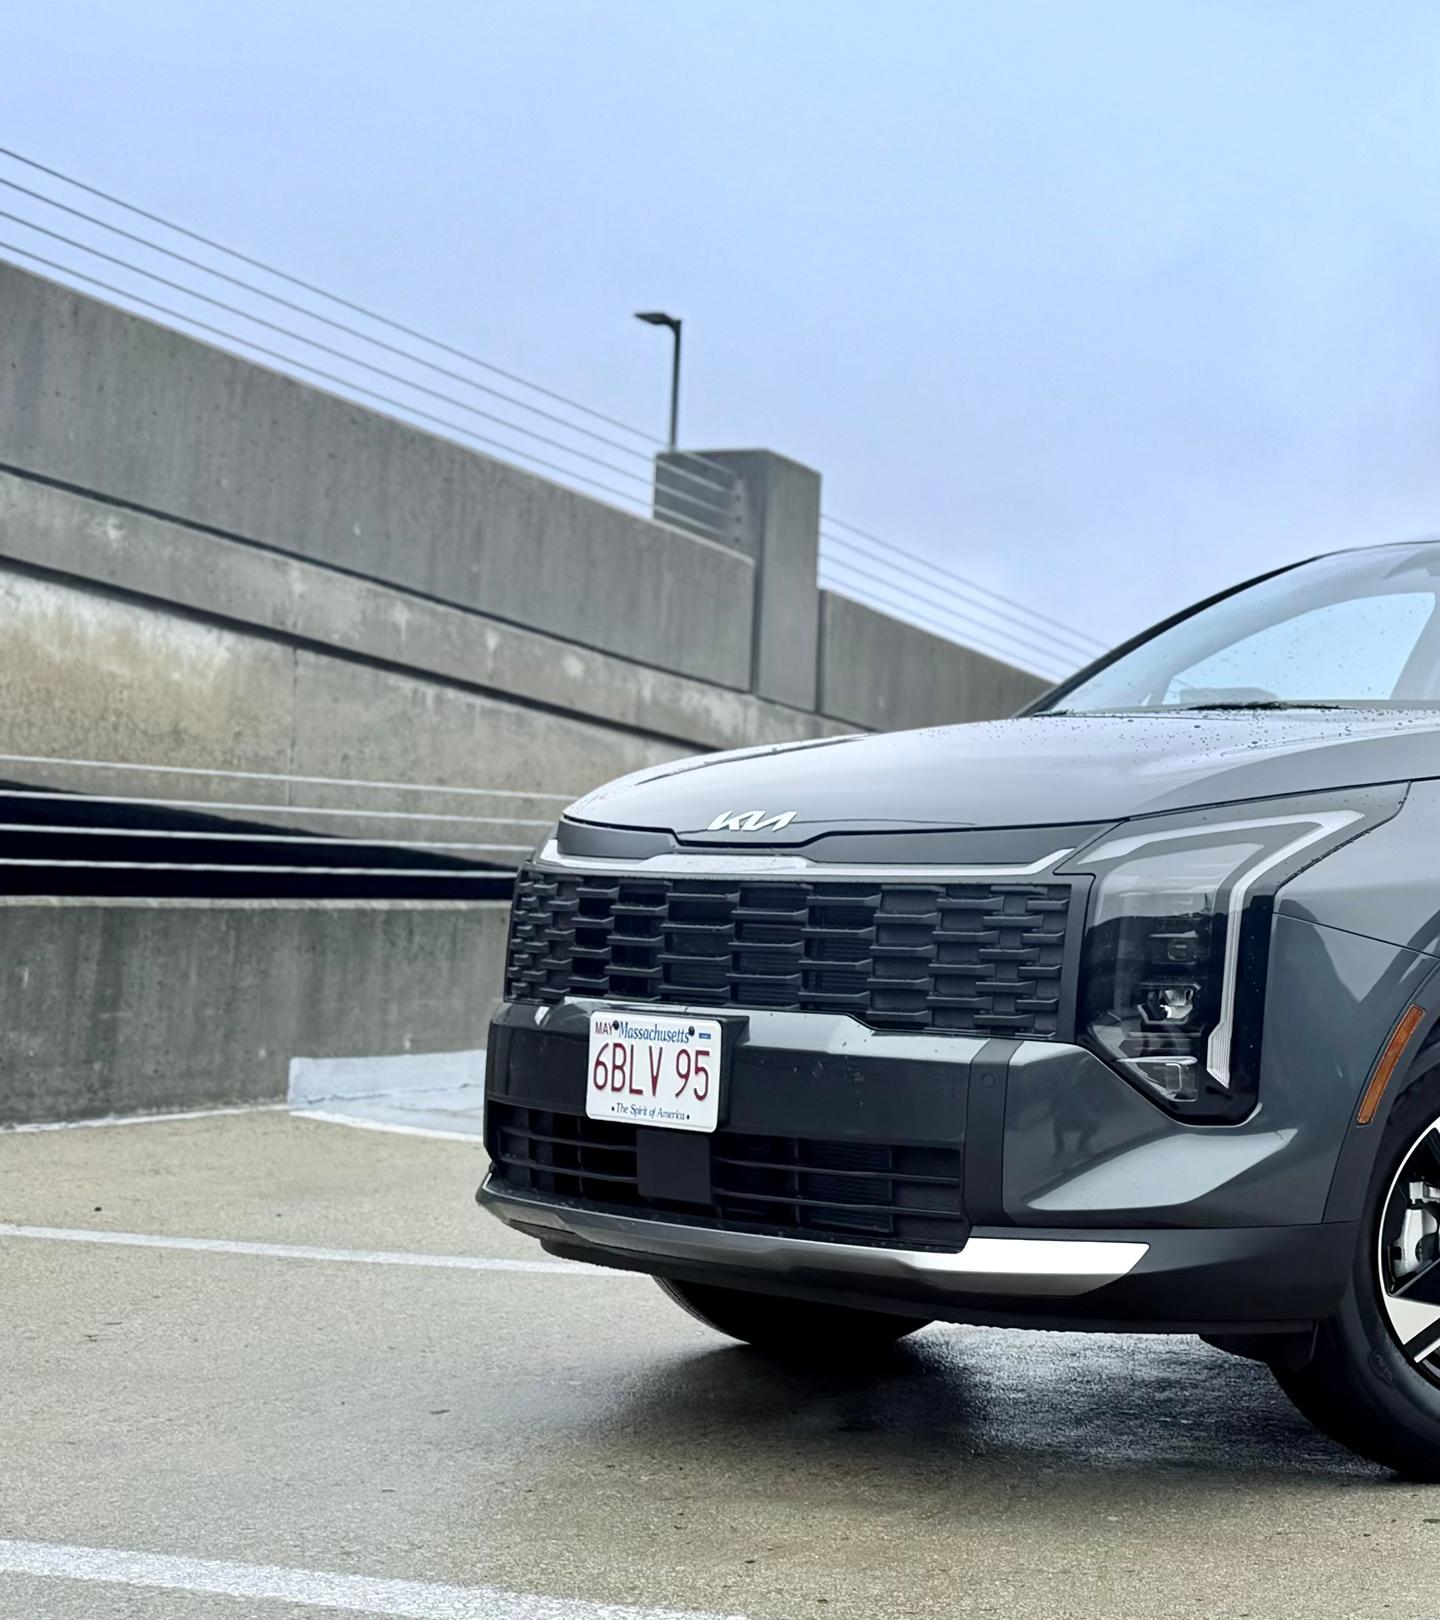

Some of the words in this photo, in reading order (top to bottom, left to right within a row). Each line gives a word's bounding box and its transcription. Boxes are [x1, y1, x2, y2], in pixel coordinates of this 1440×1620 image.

[595, 1021, 613, 1035] MAY
[618, 1021, 690, 1044] Massachusetts
[593, 1042, 663, 1097] 6BLV
[675, 1048, 710, 1102] 95
[616, 1102, 629, 1115] The
[630, 1104, 647, 1117] Spirit
[649, 1107, 656, 1119] of
[656, 1108, 685, 1120] America
